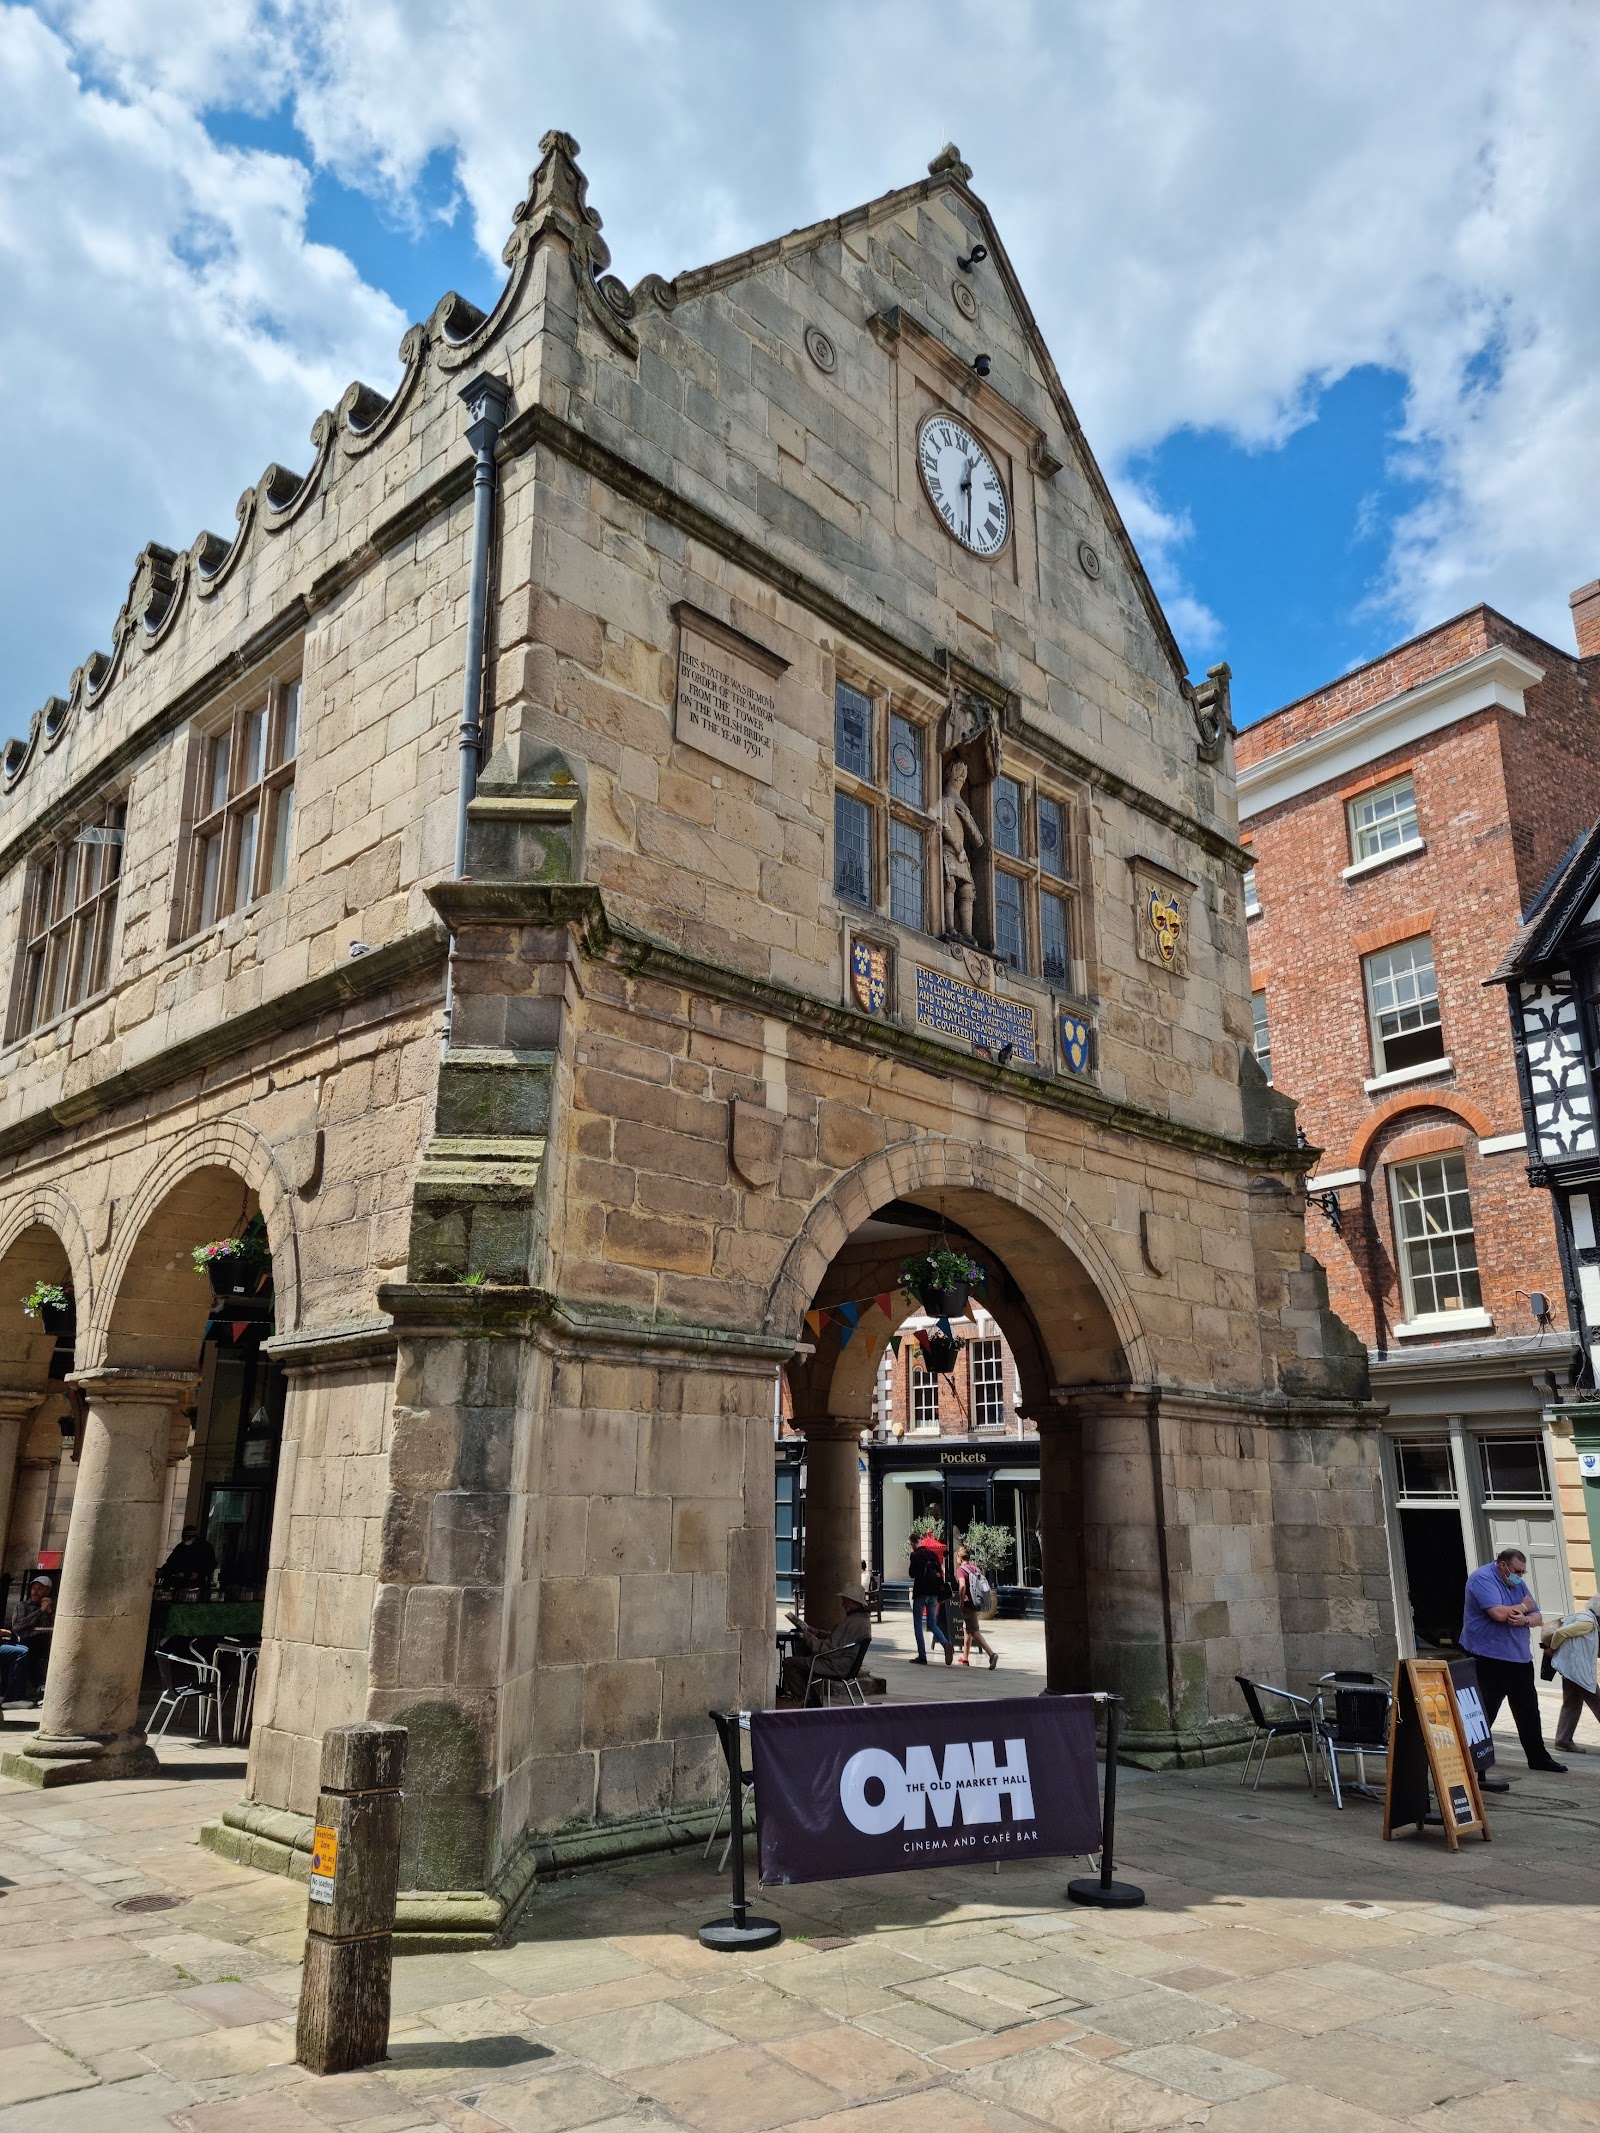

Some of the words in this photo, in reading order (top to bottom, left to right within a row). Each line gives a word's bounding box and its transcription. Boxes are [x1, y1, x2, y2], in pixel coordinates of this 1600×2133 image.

[928, 434, 942, 454] X
[954, 431, 970, 456] XII
[983, 481, 995, 491] II
[680, 651, 699, 668] THIS
[700, 662, 730, 686] STATUE
[731, 679, 746, 694] WAS
[681, 665, 692, 679] BY
[692, 670, 717, 692] ORDER
[719, 685, 730, 699] OF
[731, 691, 748, 710] THE
[748, 701, 773, 723] MAYOR
[689, 683, 712, 702] FROM
[713, 695, 730, 714] THE
[734, 705, 764, 731] TOWER
[680, 693, 693, 708] ON
[694, 701, 712, 717] THE
[713, 709, 743, 733] WELSH
[743, 726, 771, 748] BRIDGE
[690, 711, 699, 724] IN
[701, 718, 721, 736] THE
[721, 727, 741, 747] YEAR
[918, 968, 933, 982] THE
[936, 974, 949, 986] XV
[951, 980, 965, 993] DAY
[966, 987, 975, 996] OF
[996, 998, 1011, 1010] WAS
[1011, 1005, 1030, 1018] THIS
[918, 991, 934, 1003] AND
[936, 996, 968, 1016] THOMAS
[971, 1010, 1010, 1031] CHARLTON
[1013, 1026, 1032, 1038] GENT
[918, 1012, 934, 1026] AND
[936, 1019, 969, 1038] COVERED
[969, 1031, 979, 1042] IN
[986, 1005, 1013, 1020] WILLIAM
[1013, 1015, 1033, 1028] IONES
[940, 1451, 987, 1463] Pockets
[839, 1738, 1036, 1836] OMH
[906, 1783, 925, 1793] THE
[930, 1780, 952, 1791] OLD
[956, 1777, 998, 1789] MARKET
[1002, 1774, 1028, 1785] HALL
[317, 1830, 336, 1841] Restricted
[321, 1841, 330, 1849] Zone
[903, 1839, 949, 1853] CINEMA
[953, 1836, 977, 1848] AND
[983, 1831, 1011, 1845] CAFÉ
[1017, 1831, 1039, 1841] BAR
[319, 1881, 333, 1891] loading
